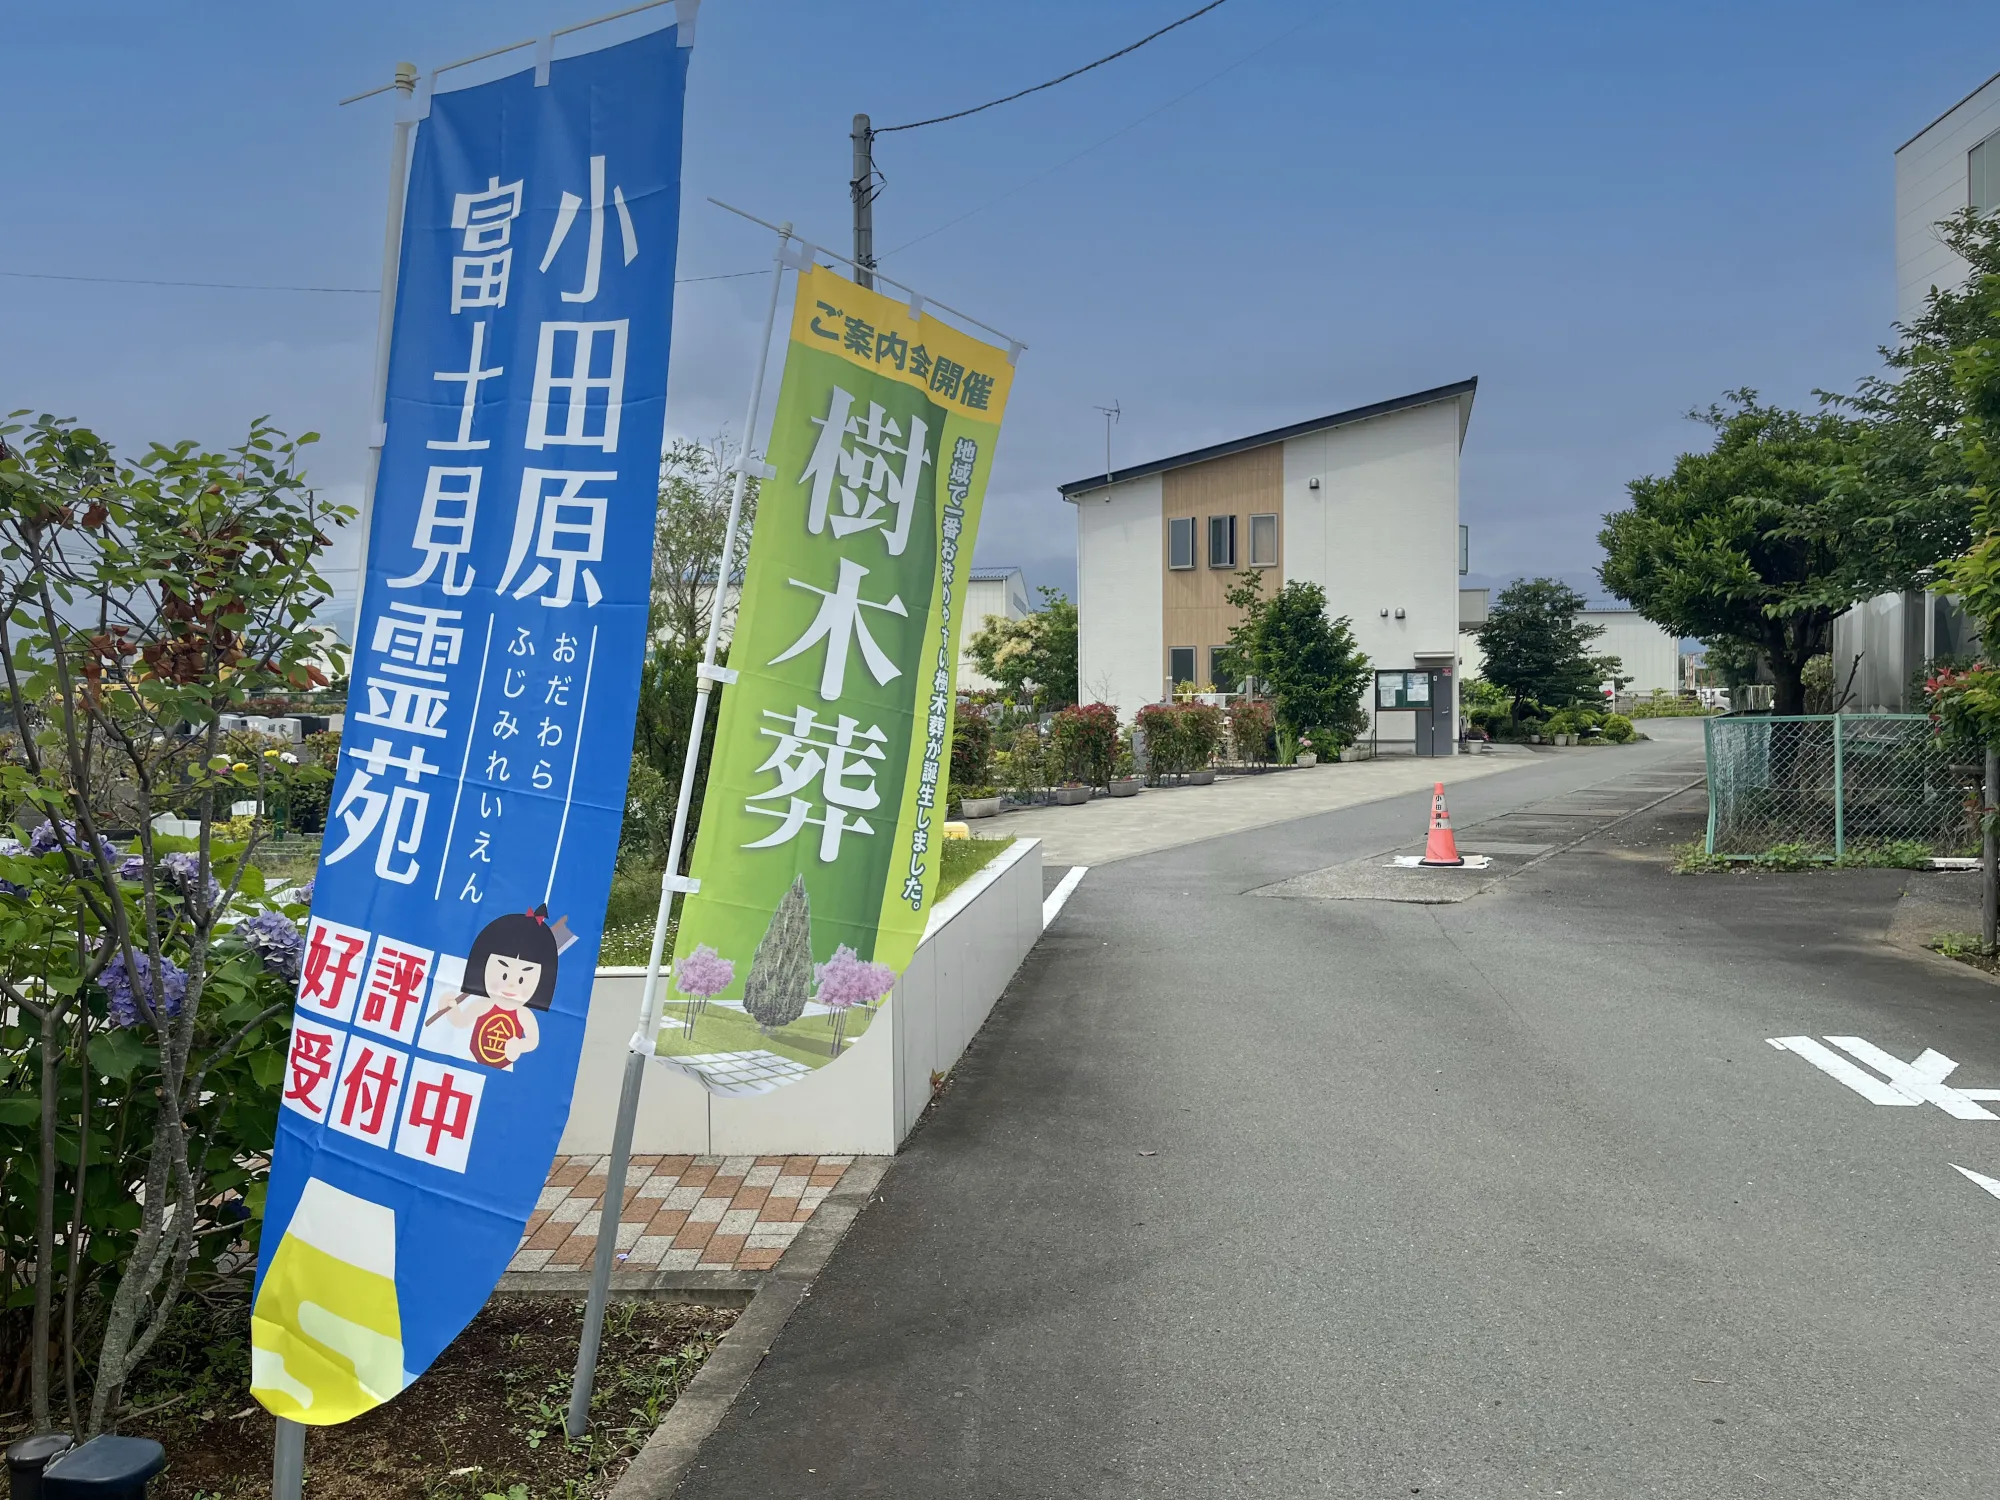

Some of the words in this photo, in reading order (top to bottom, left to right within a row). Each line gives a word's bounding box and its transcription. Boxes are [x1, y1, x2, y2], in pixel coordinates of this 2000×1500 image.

[495, 155, 638, 608] 小田原
[810, 300, 995, 411] ご案内会開催
[325, 176, 524, 885] 富士見霊苑
[739, 384, 931, 862] 樹木葬
[459, 627, 535, 903] ふじみれいえん
[531, 633, 577, 790] おだわら
[300, 925, 426, 1032] 好評
[484, 1021, 510, 1053] 金
[285, 1028, 473, 1156] 受付中
